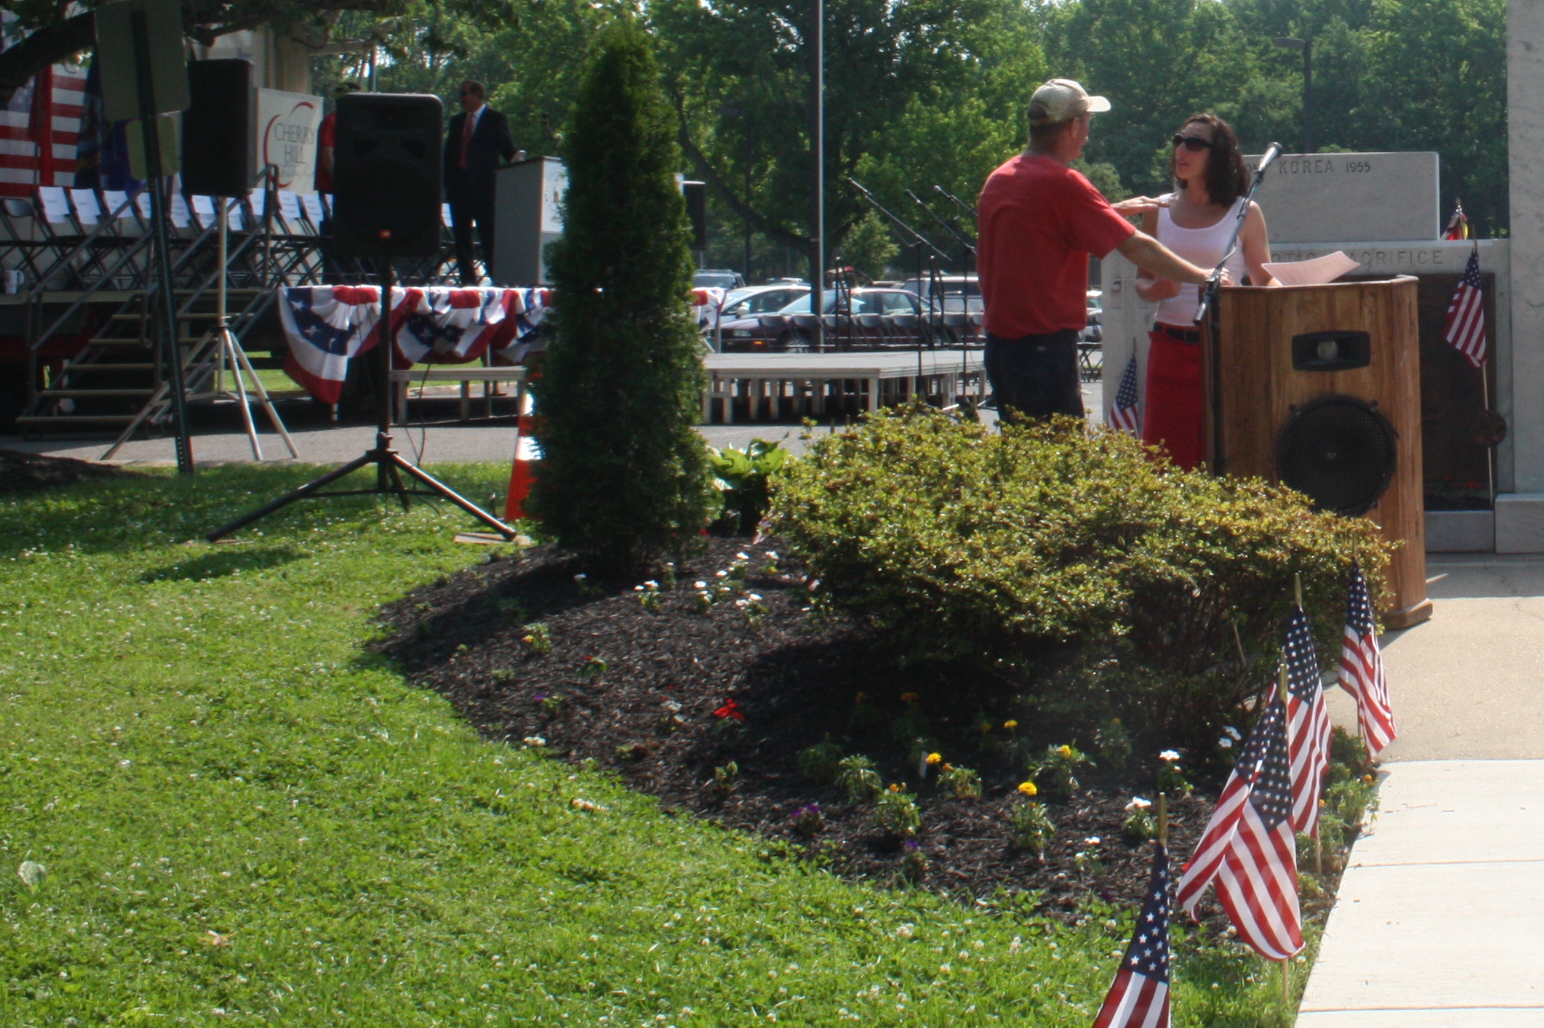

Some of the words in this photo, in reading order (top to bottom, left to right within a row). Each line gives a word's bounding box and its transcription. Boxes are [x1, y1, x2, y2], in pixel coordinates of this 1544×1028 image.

[275, 122, 314, 145] CHERRY
[284, 144, 306, 164] HILL
[1279, 160, 1334, 174] KOREA
[1346, 162, 1371, 173] 1955
